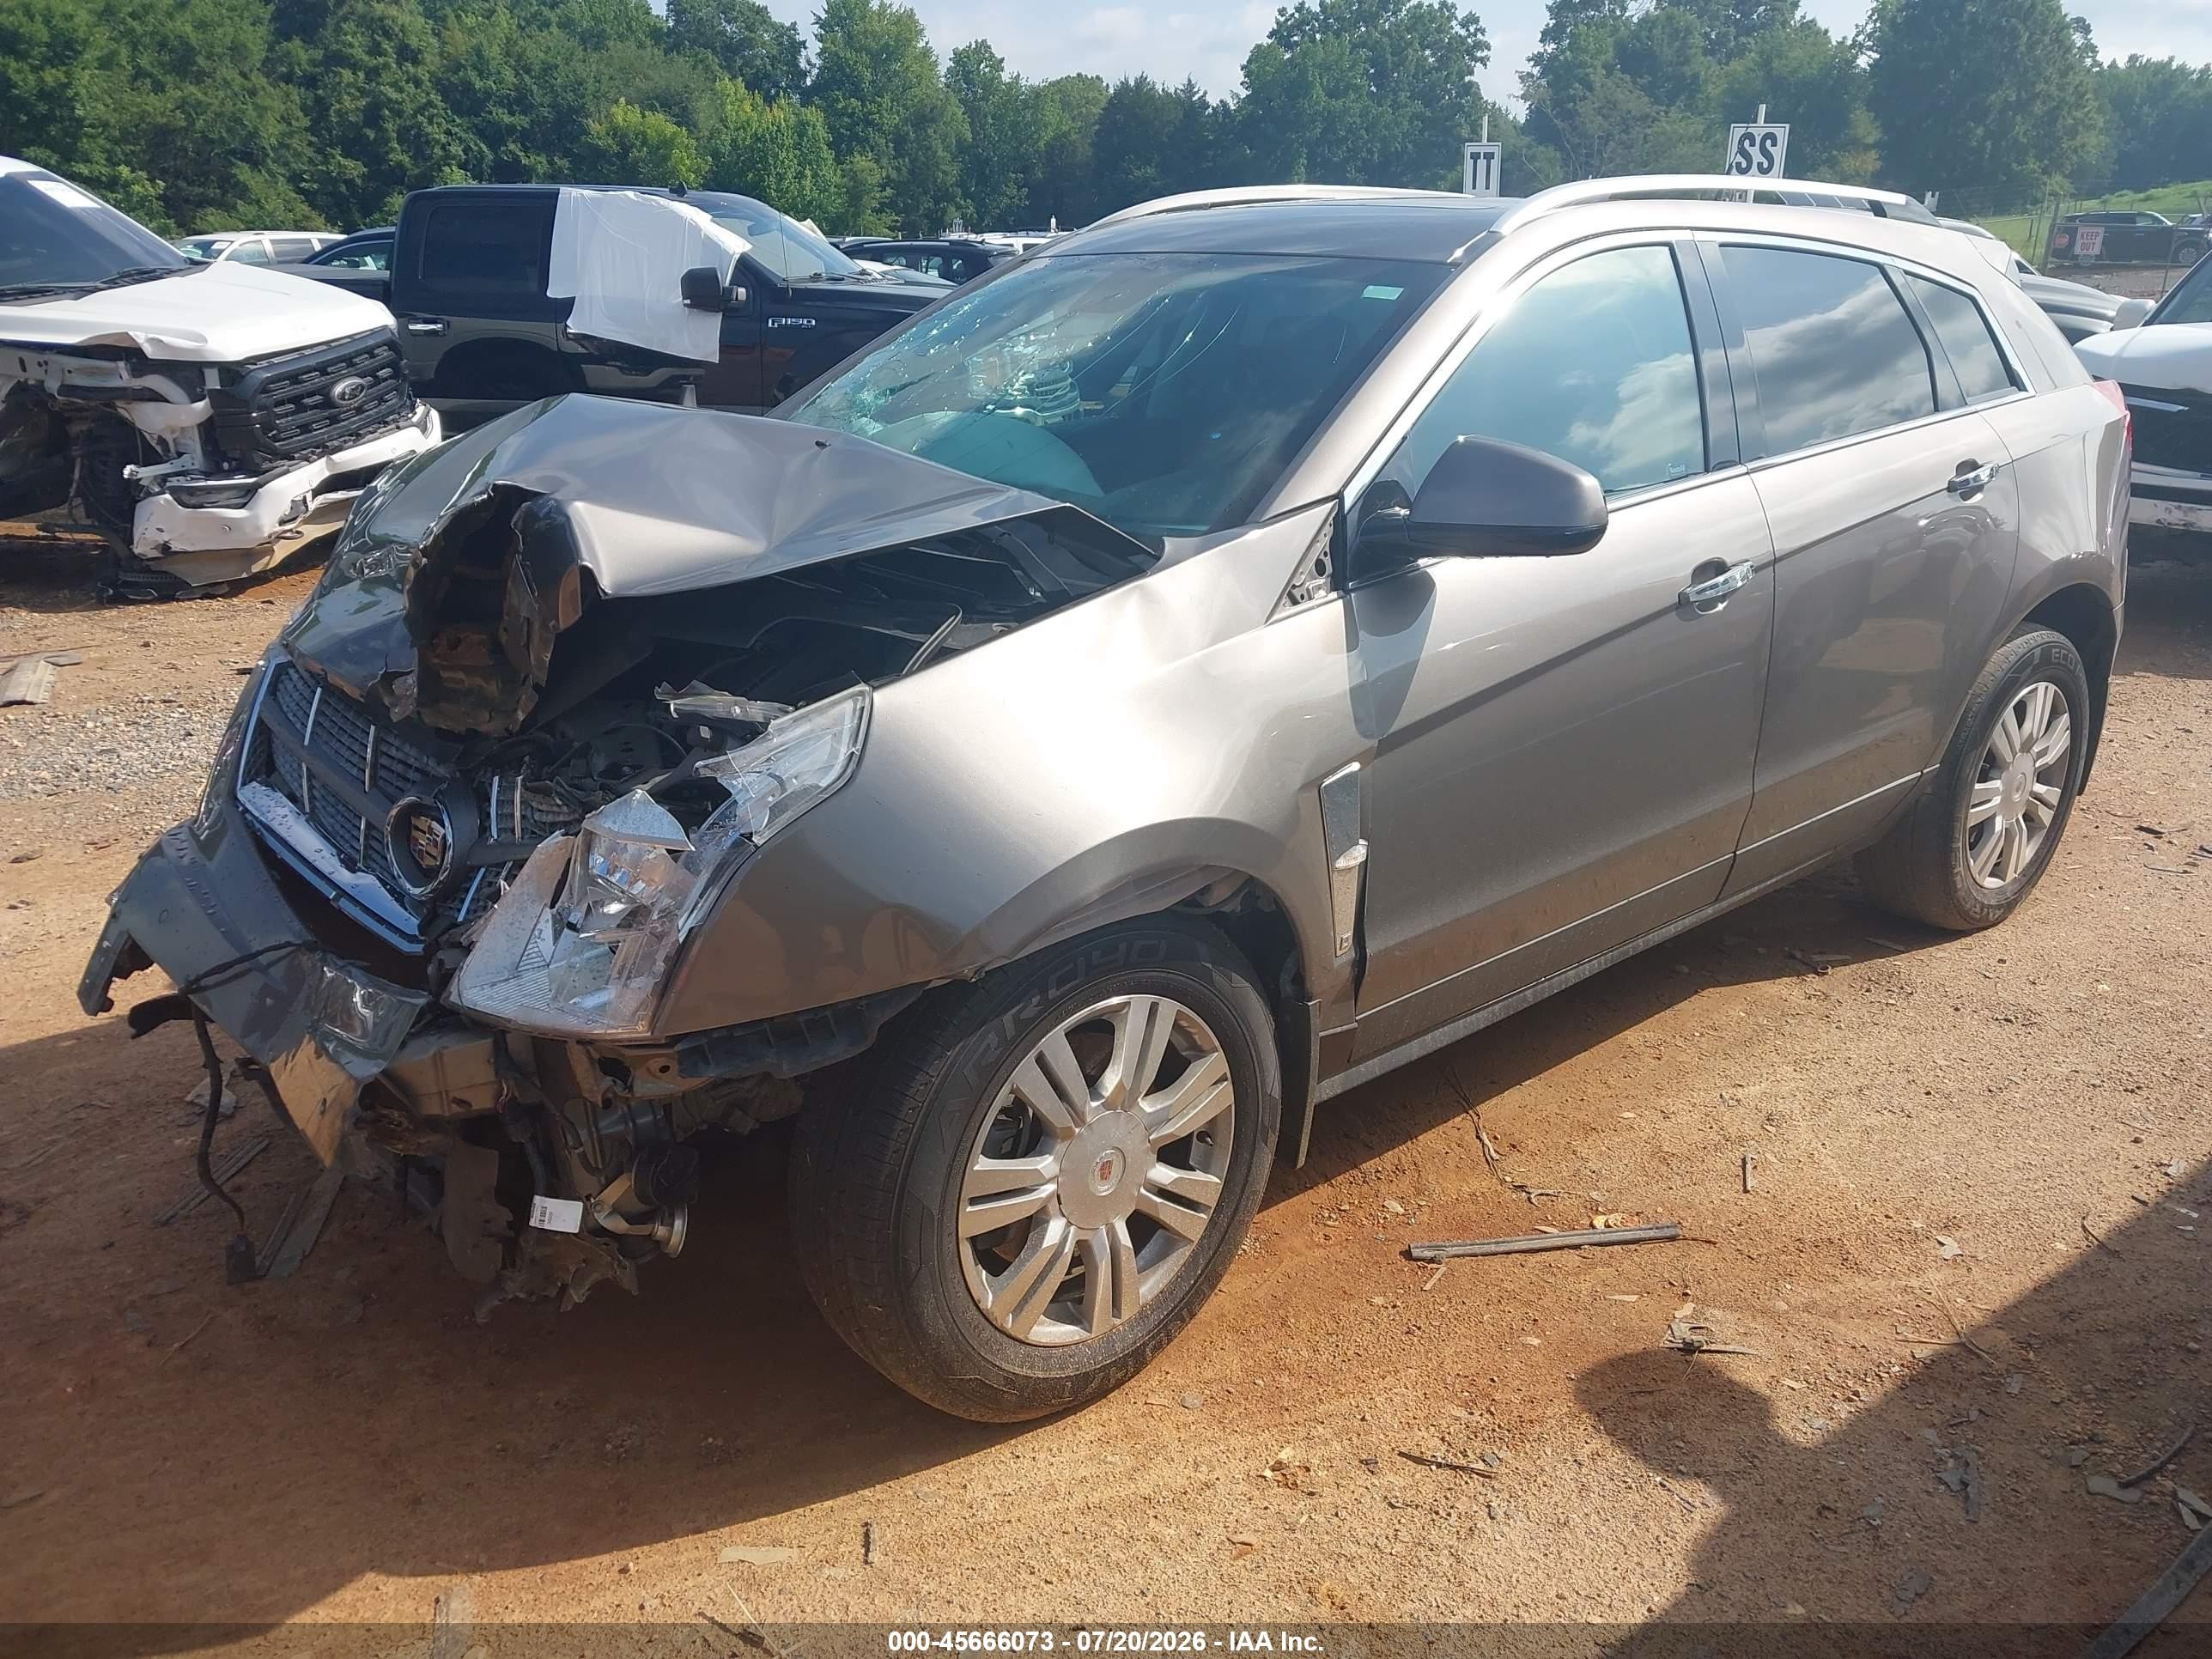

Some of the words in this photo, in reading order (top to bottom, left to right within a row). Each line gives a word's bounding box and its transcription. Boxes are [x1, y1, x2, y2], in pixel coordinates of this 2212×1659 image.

[1735, 131, 1778, 175] SS
[1470, 152, 1495, 190] TT
[2080, 231, 2100, 241] KEEP
[2080, 241, 2096, 252] OUT
[768, 317, 816, 328] F150
